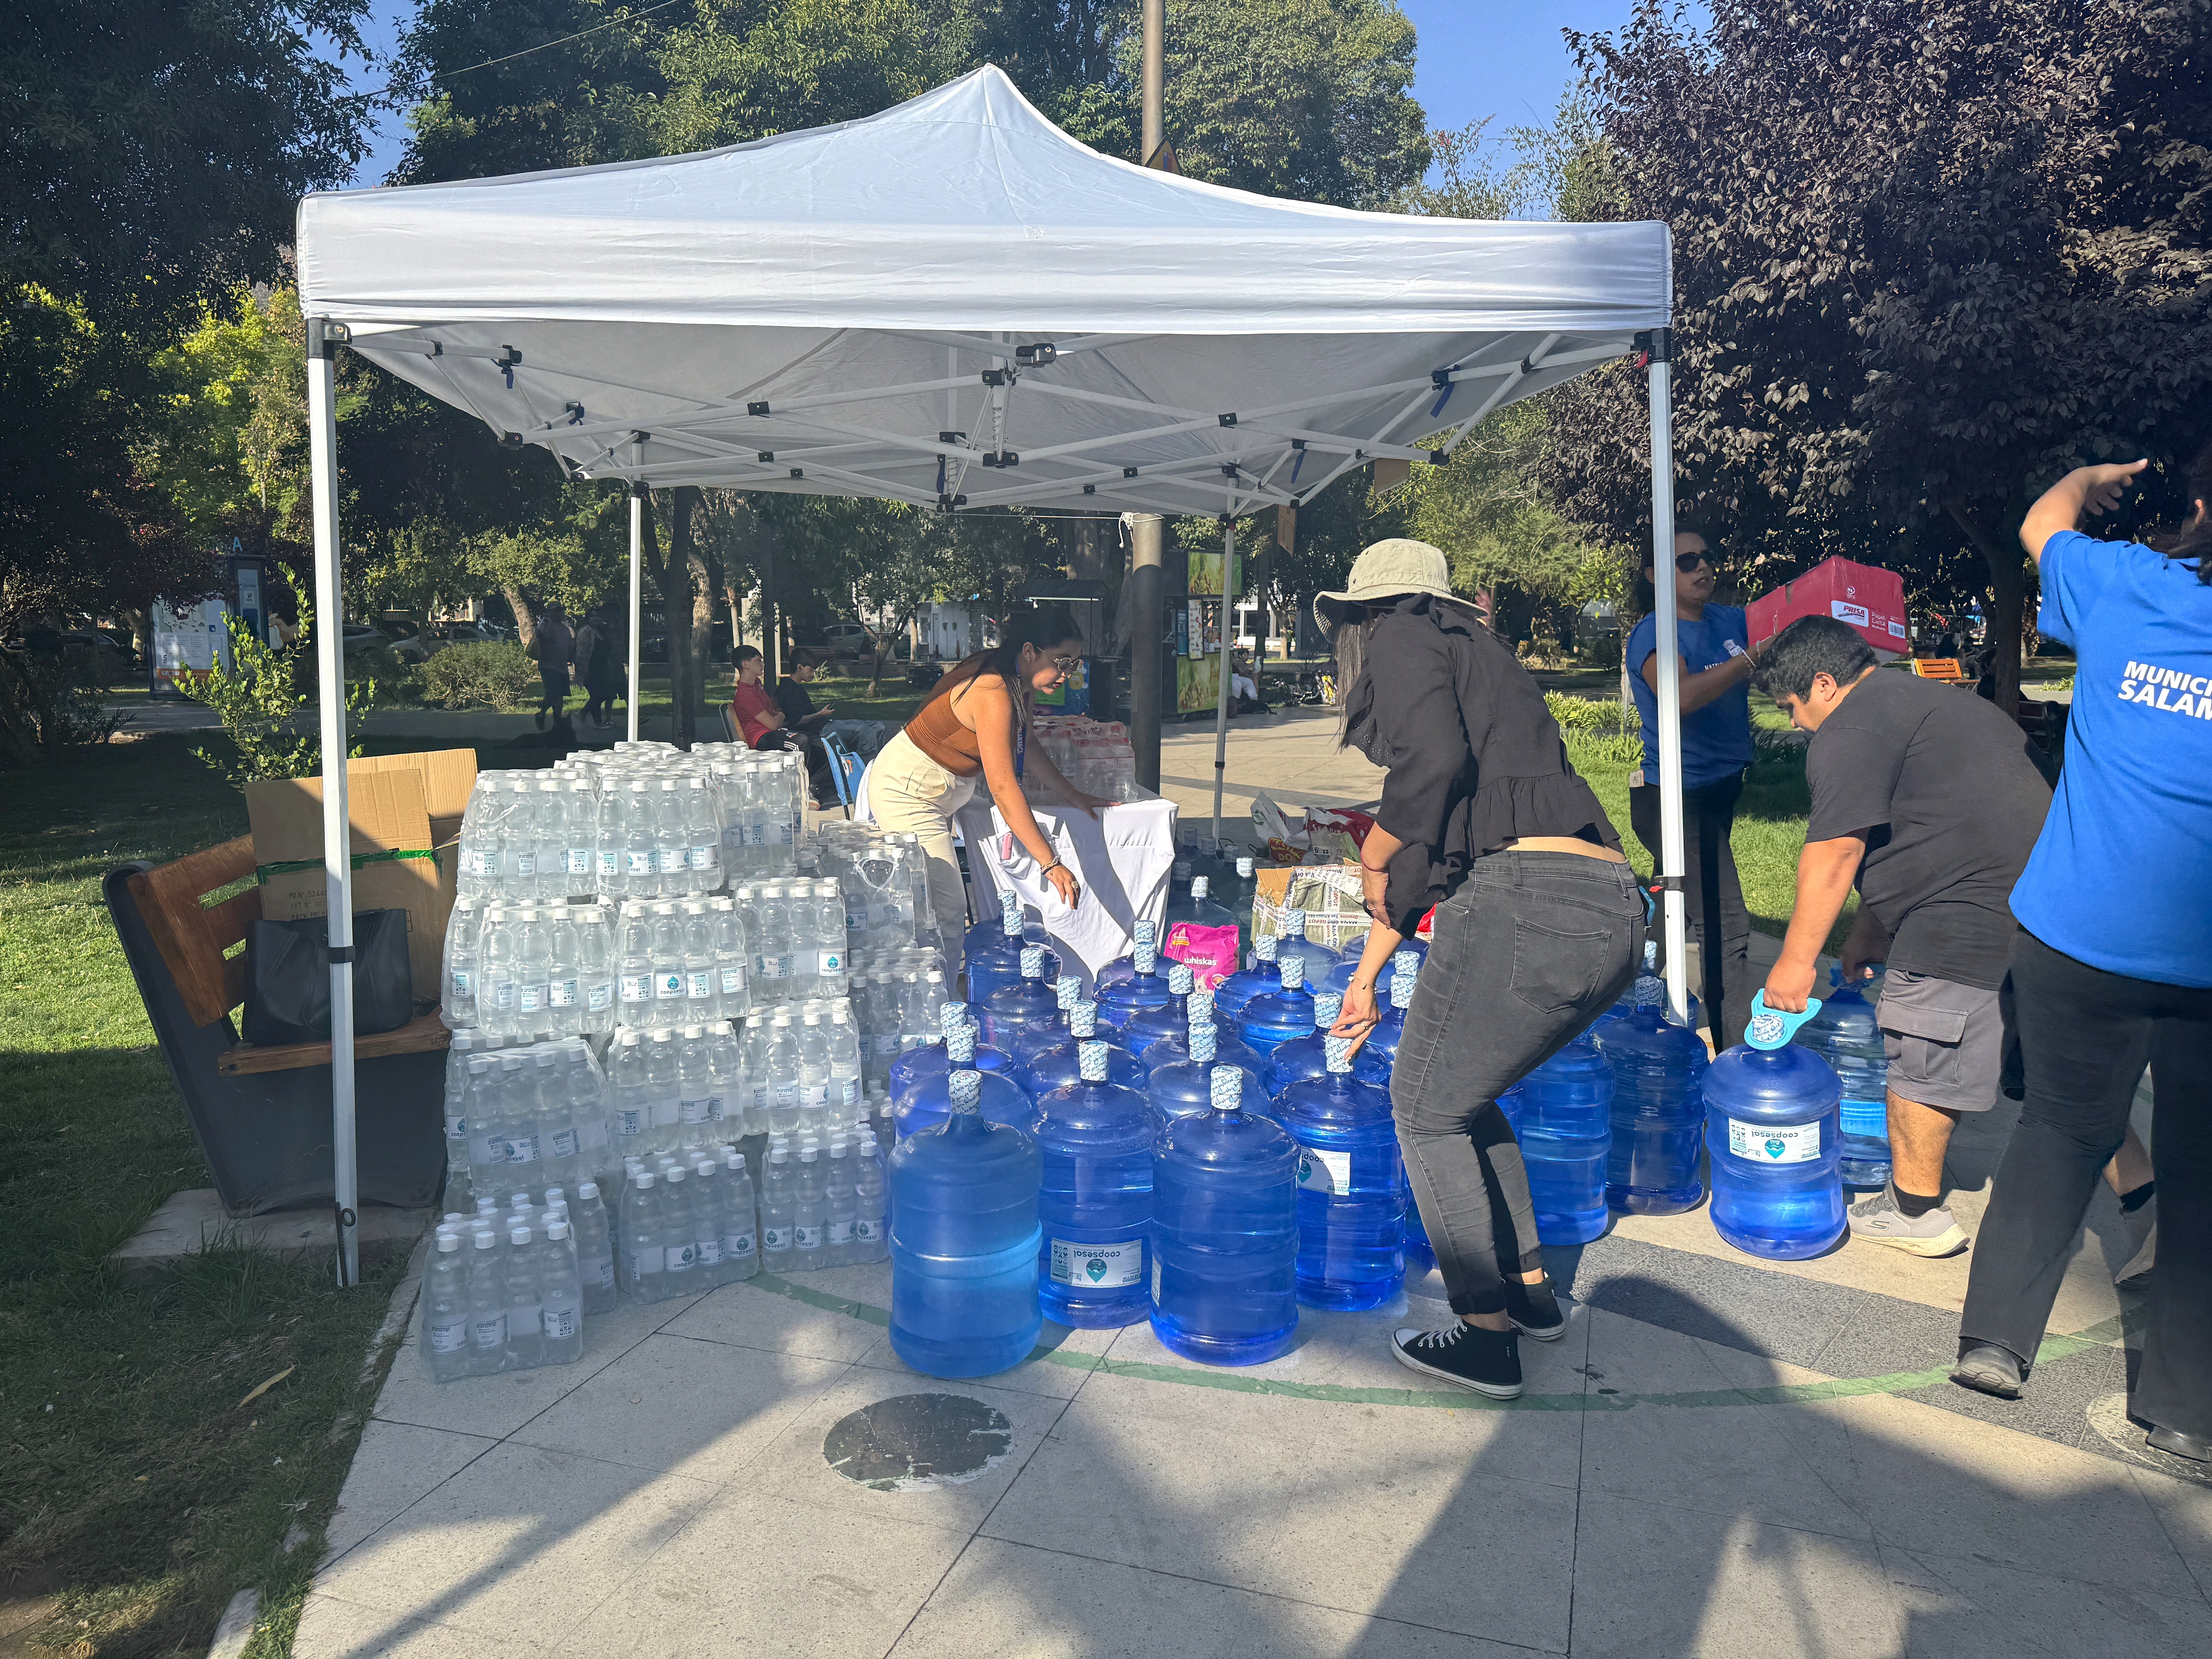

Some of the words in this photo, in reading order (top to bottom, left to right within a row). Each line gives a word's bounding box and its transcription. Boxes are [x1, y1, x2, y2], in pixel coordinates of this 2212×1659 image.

[1843, 605, 1865, 615] PRISA
[1184, 956, 1218, 966] whiskas
[1073, 1249, 1120, 1258] coopsesal
